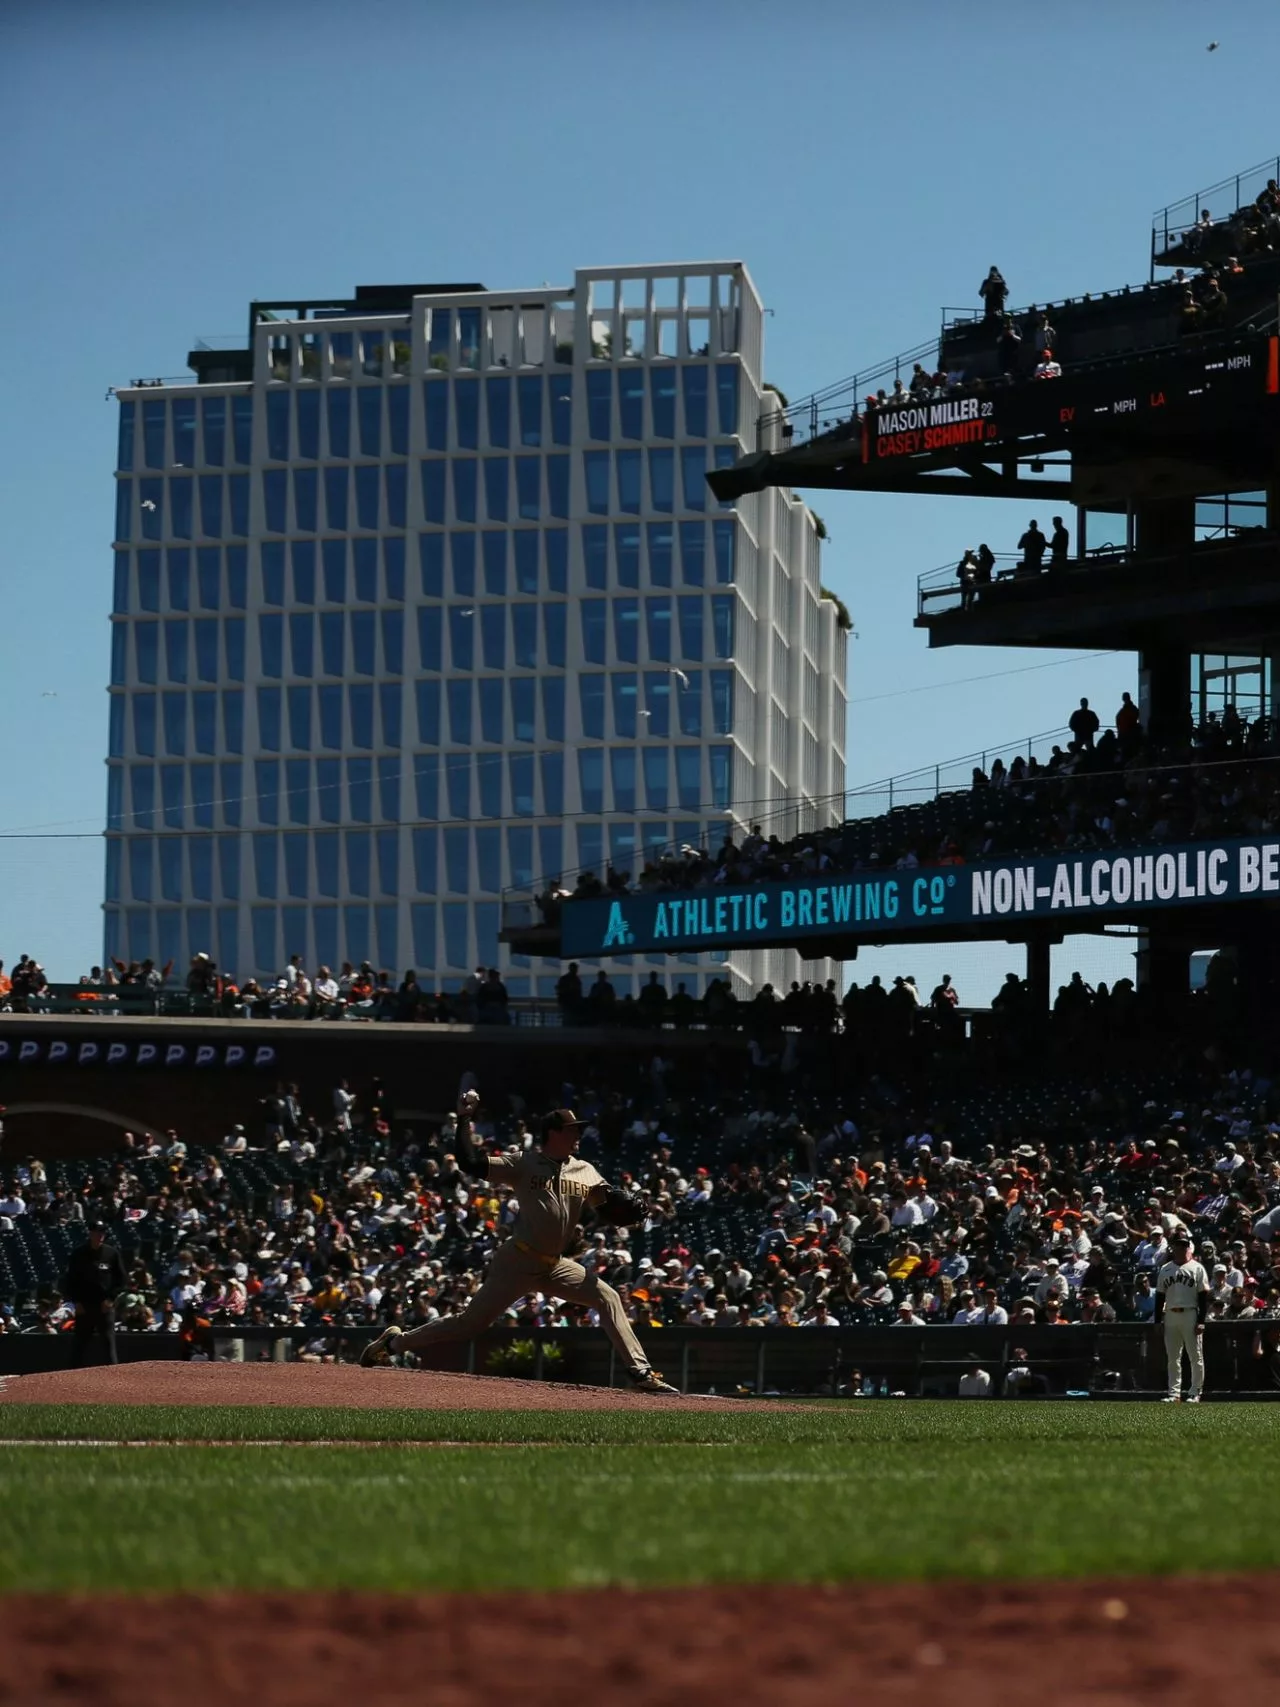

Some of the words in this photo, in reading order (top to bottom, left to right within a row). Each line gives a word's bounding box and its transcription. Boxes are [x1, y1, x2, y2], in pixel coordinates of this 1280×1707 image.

[1227, 355, 1252, 370] MPH
[878, 407, 929, 435] MASON
[930, 398, 979, 426] MILLER
[981, 402, 994, 416] 22
[1059, 407, 1076, 423] EV
[1113, 398, 1137, 414] MPH
[1150, 391, 1166, 407] LA
[876, 430, 921, 458] CASEY
[923, 419, 985, 450] SCHMITT
[971, 848, 1229, 916] NON-ALCOHOLIC
[653, 893, 769, 938] ATHLETIC
[780, 879, 899, 928] BREWING
[560, 1179, 591, 1199] DIEG
